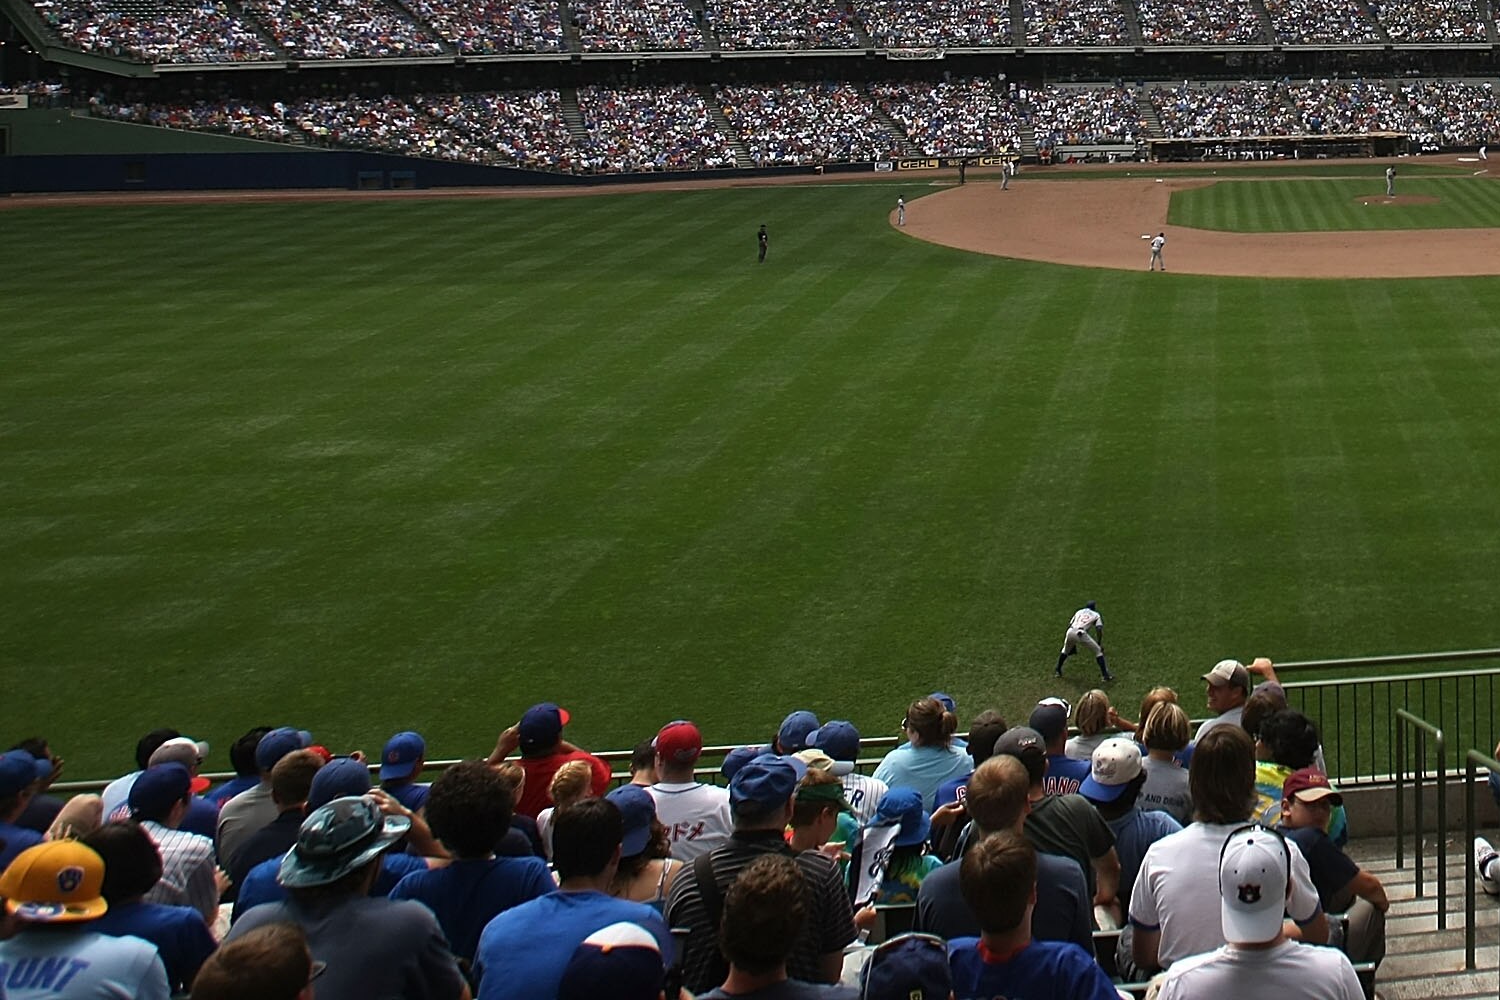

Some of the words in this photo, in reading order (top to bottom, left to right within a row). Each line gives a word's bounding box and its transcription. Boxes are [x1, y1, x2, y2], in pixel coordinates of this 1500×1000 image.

[901, 160, 935, 168] GEHL
[1077, 614, 1090, 625] 12
[1043, 776, 1080, 796] ANO
[1145, 794, 1161, 805] AND
